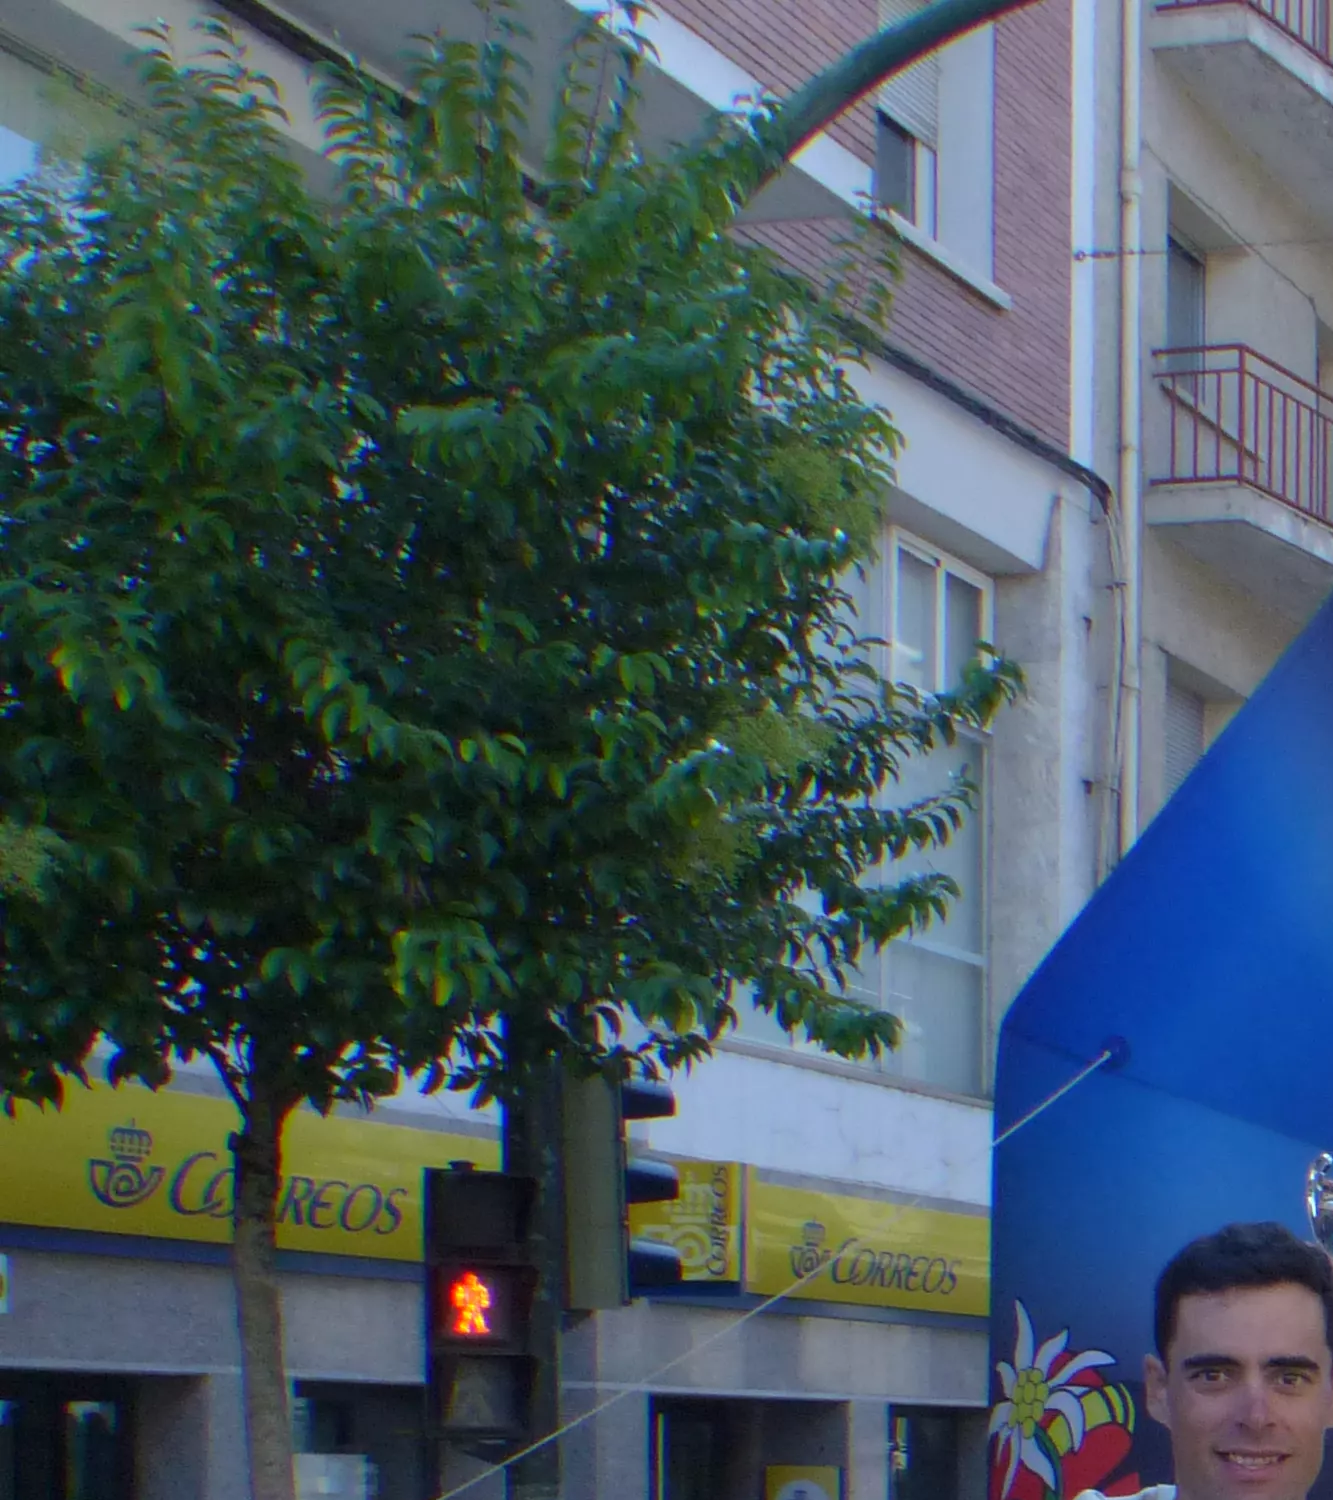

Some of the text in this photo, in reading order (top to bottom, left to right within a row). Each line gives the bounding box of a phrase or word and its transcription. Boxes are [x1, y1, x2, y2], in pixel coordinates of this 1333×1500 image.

[167, 1151, 409, 1235] COREOS
[704, 1164, 728, 1277] CORREOS
[831, 1236, 964, 1296] CORREOS
